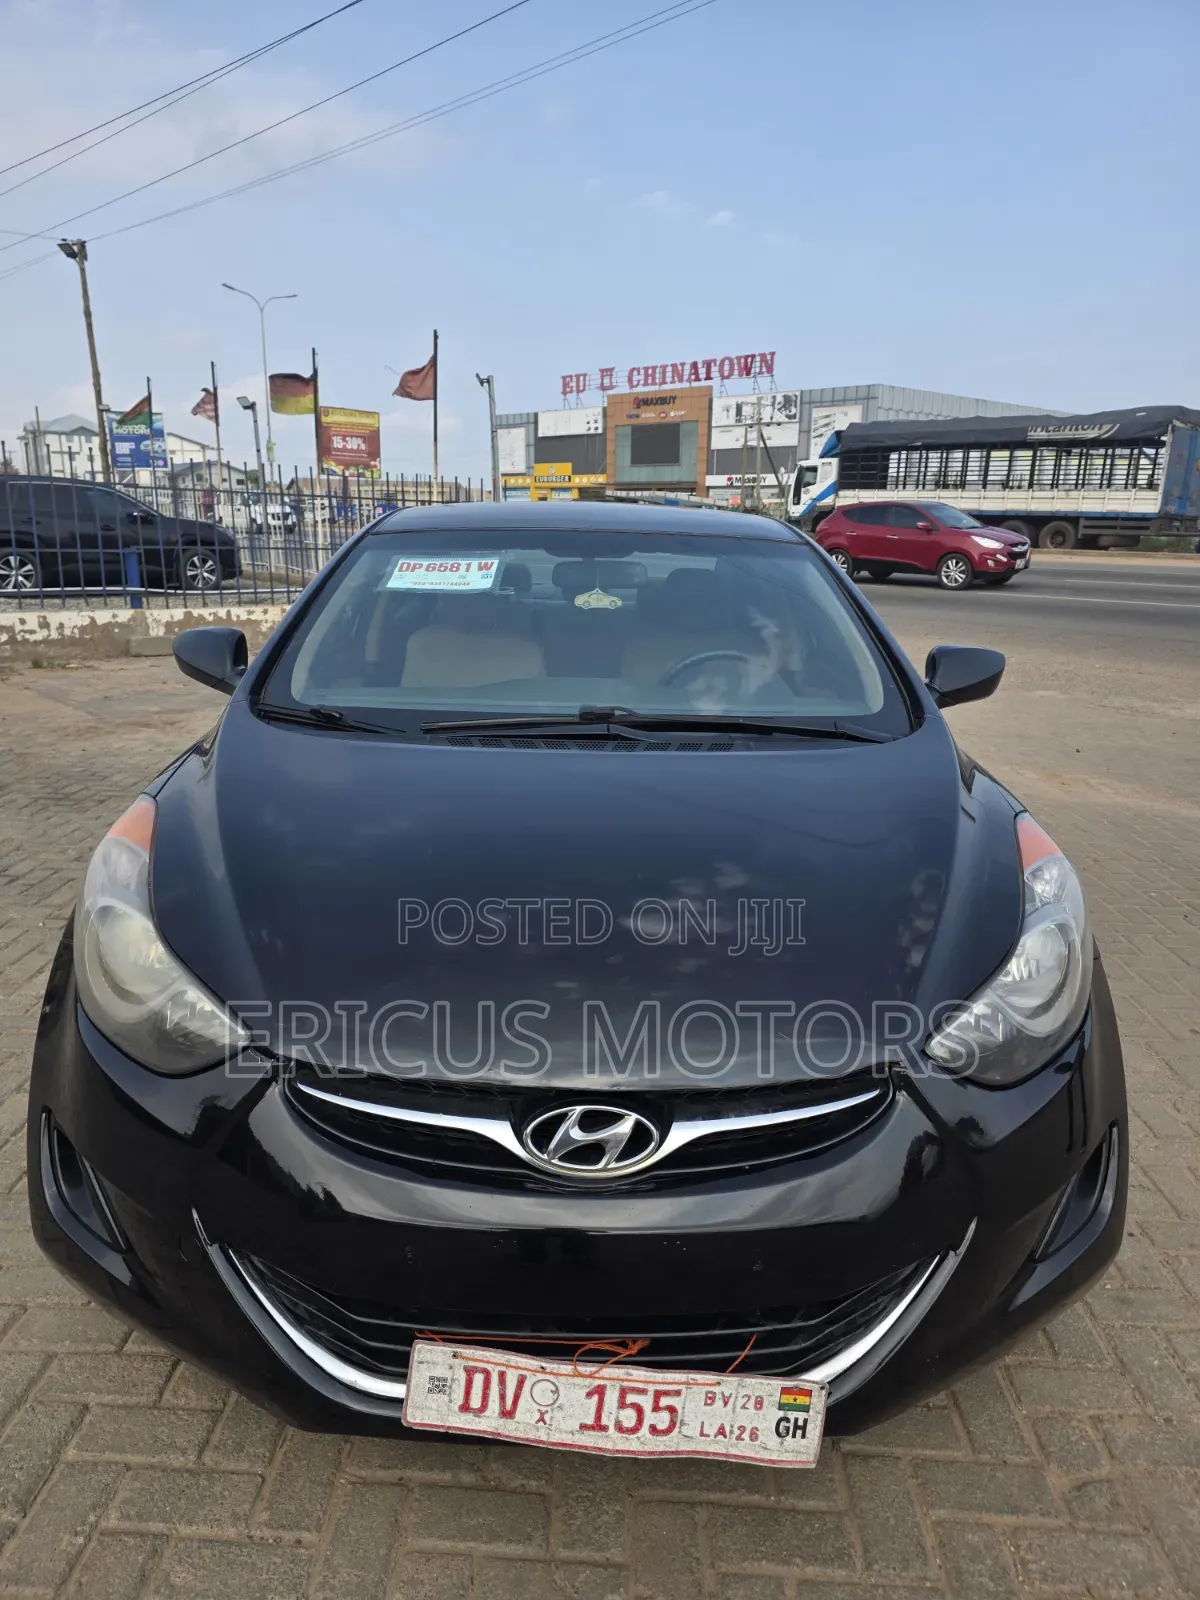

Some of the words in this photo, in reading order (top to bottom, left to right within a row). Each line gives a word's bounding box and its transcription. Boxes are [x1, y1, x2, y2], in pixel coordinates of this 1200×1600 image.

[561, 373, 588, 395] EU
[627, 351, 776, 389] CHINATOWN
[640, 395, 677, 406] MAXBUY
[332, 435, 366, 450] 15-30%
[535, 475, 570, 483] EUBURGER
[397, 561, 423, 572] DP
[425, 561, 472, 573] 6581
[477, 561, 495, 572] W
[458, 1365, 527, 1420] DV
[579, 1384, 683, 1437] 155
[699, 1421, 727, 1439] LA
[735, 1425, 760, 1442] 26
[775, 1416, 808, 1439] GH
